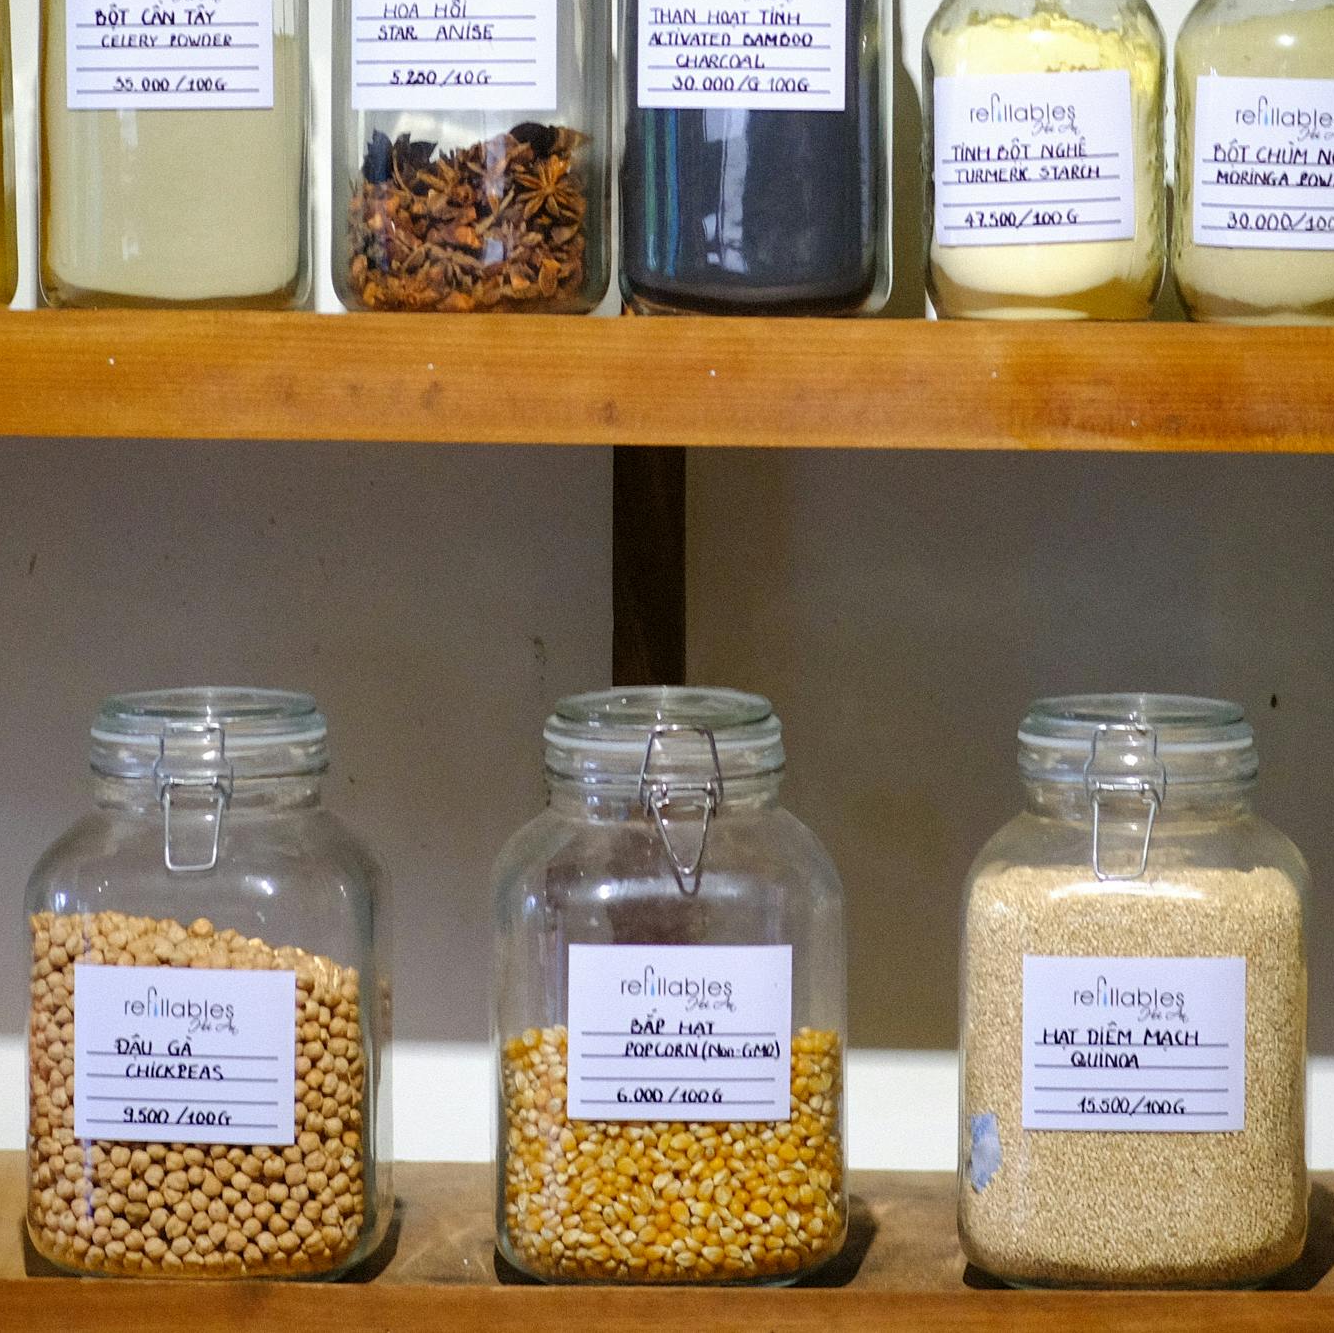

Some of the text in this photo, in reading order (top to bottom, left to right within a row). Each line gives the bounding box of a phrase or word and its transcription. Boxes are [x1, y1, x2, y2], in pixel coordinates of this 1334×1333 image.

[384, 3, 419, 19] HOA
[651, 8, 696, 24] THAN
[102, 34, 232, 47] CELERY POWDER
[378, 25, 418, 40] STAR
[743, 33, 812, 46] BAMBOO
[677, 55, 765, 68] CHARCOAL
[970, 93, 1075, 123] refillables
[1039, 165, 1099, 179] STARCH
[621, 965, 732, 997] refillables
[1074, 976, 1184, 1008] refillables
[125, 987, 234, 1019] refillables
